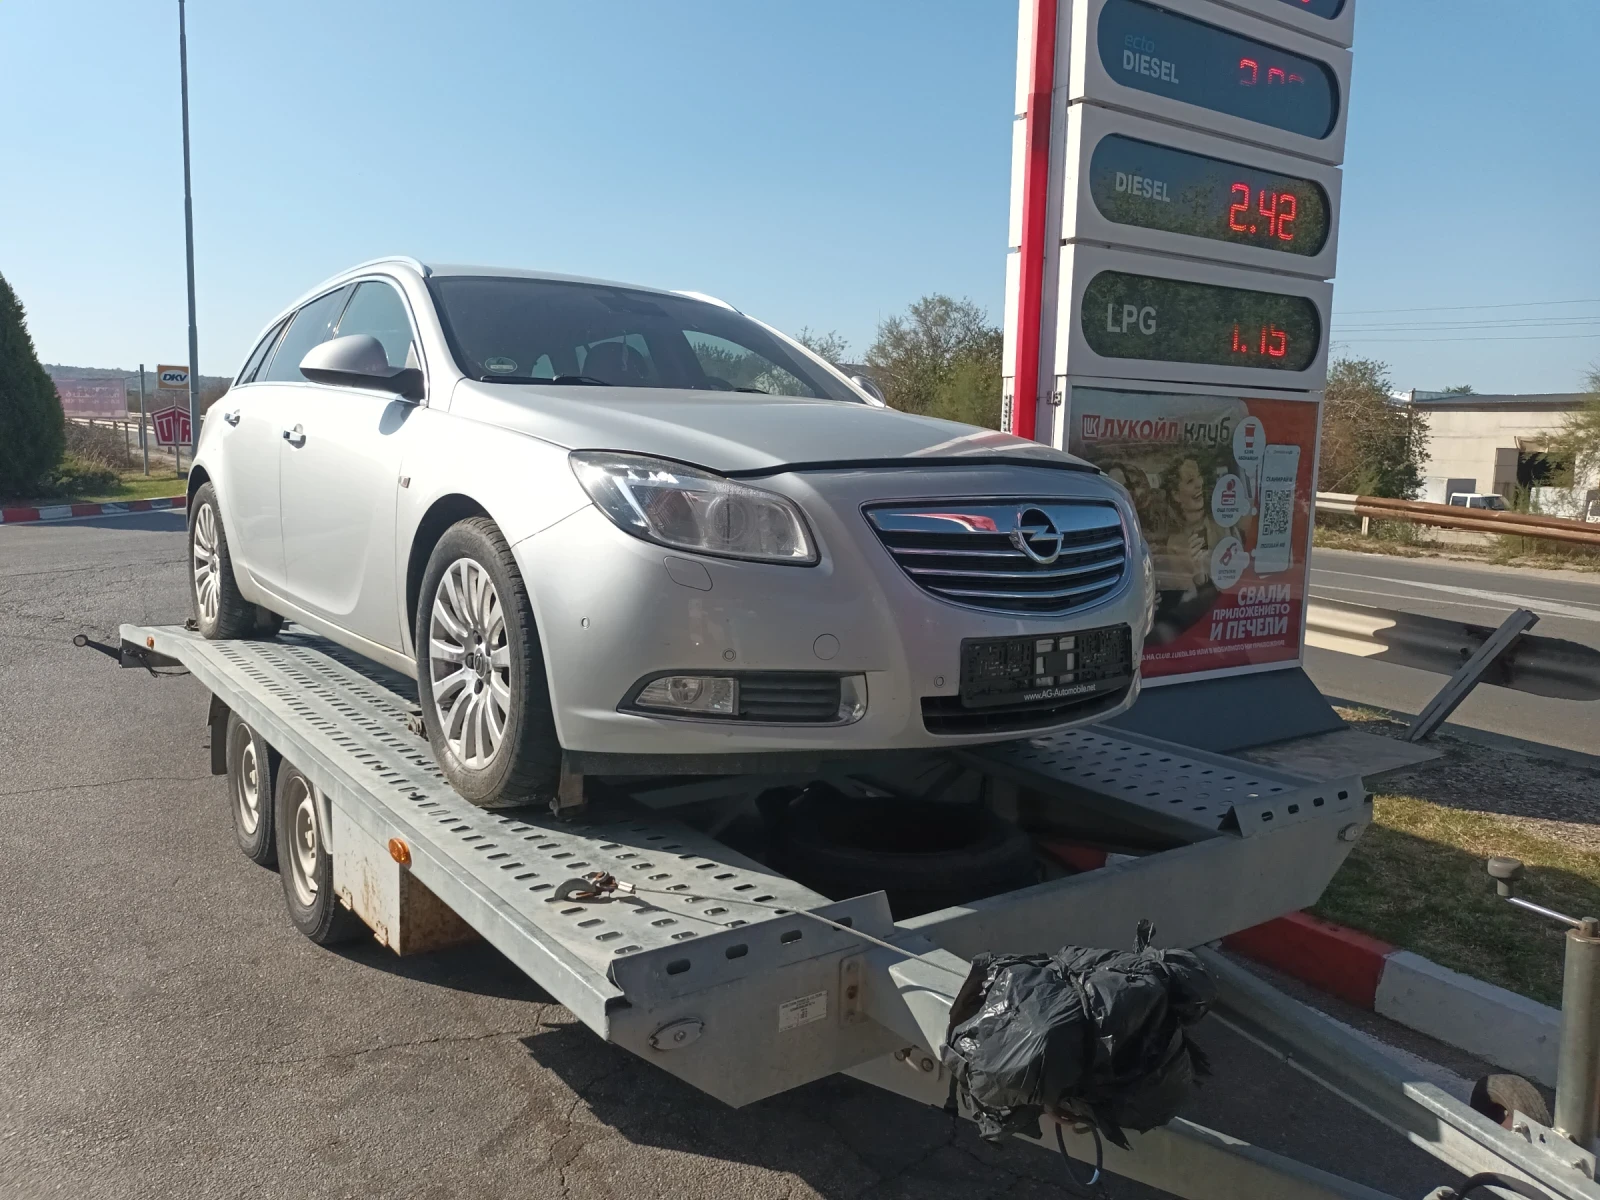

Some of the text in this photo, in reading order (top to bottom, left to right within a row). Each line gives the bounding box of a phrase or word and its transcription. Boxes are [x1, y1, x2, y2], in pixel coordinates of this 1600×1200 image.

[1124, 34, 1155, 53] ecto
[1122, 49, 1179, 84] DIESEL
[1115, 171, 1171, 203] DIESEL
[1229, 181, 1297, 241] 2.42
[1107, 303, 1157, 335] LPG
[163, 373, 188, 382] DKV
[1100, 416, 1231, 448] ЛУКОЙЛ клуб
[1237, 583, 1291, 606] СВАЛИ
[1212, 603, 1290, 620] ПРИЛОЖЕНИЕТО
[1209, 616, 1288, 641] И ПЕЧЕЛИ
[1023, 684, 1096, 701] www.AG-Automobile.net
